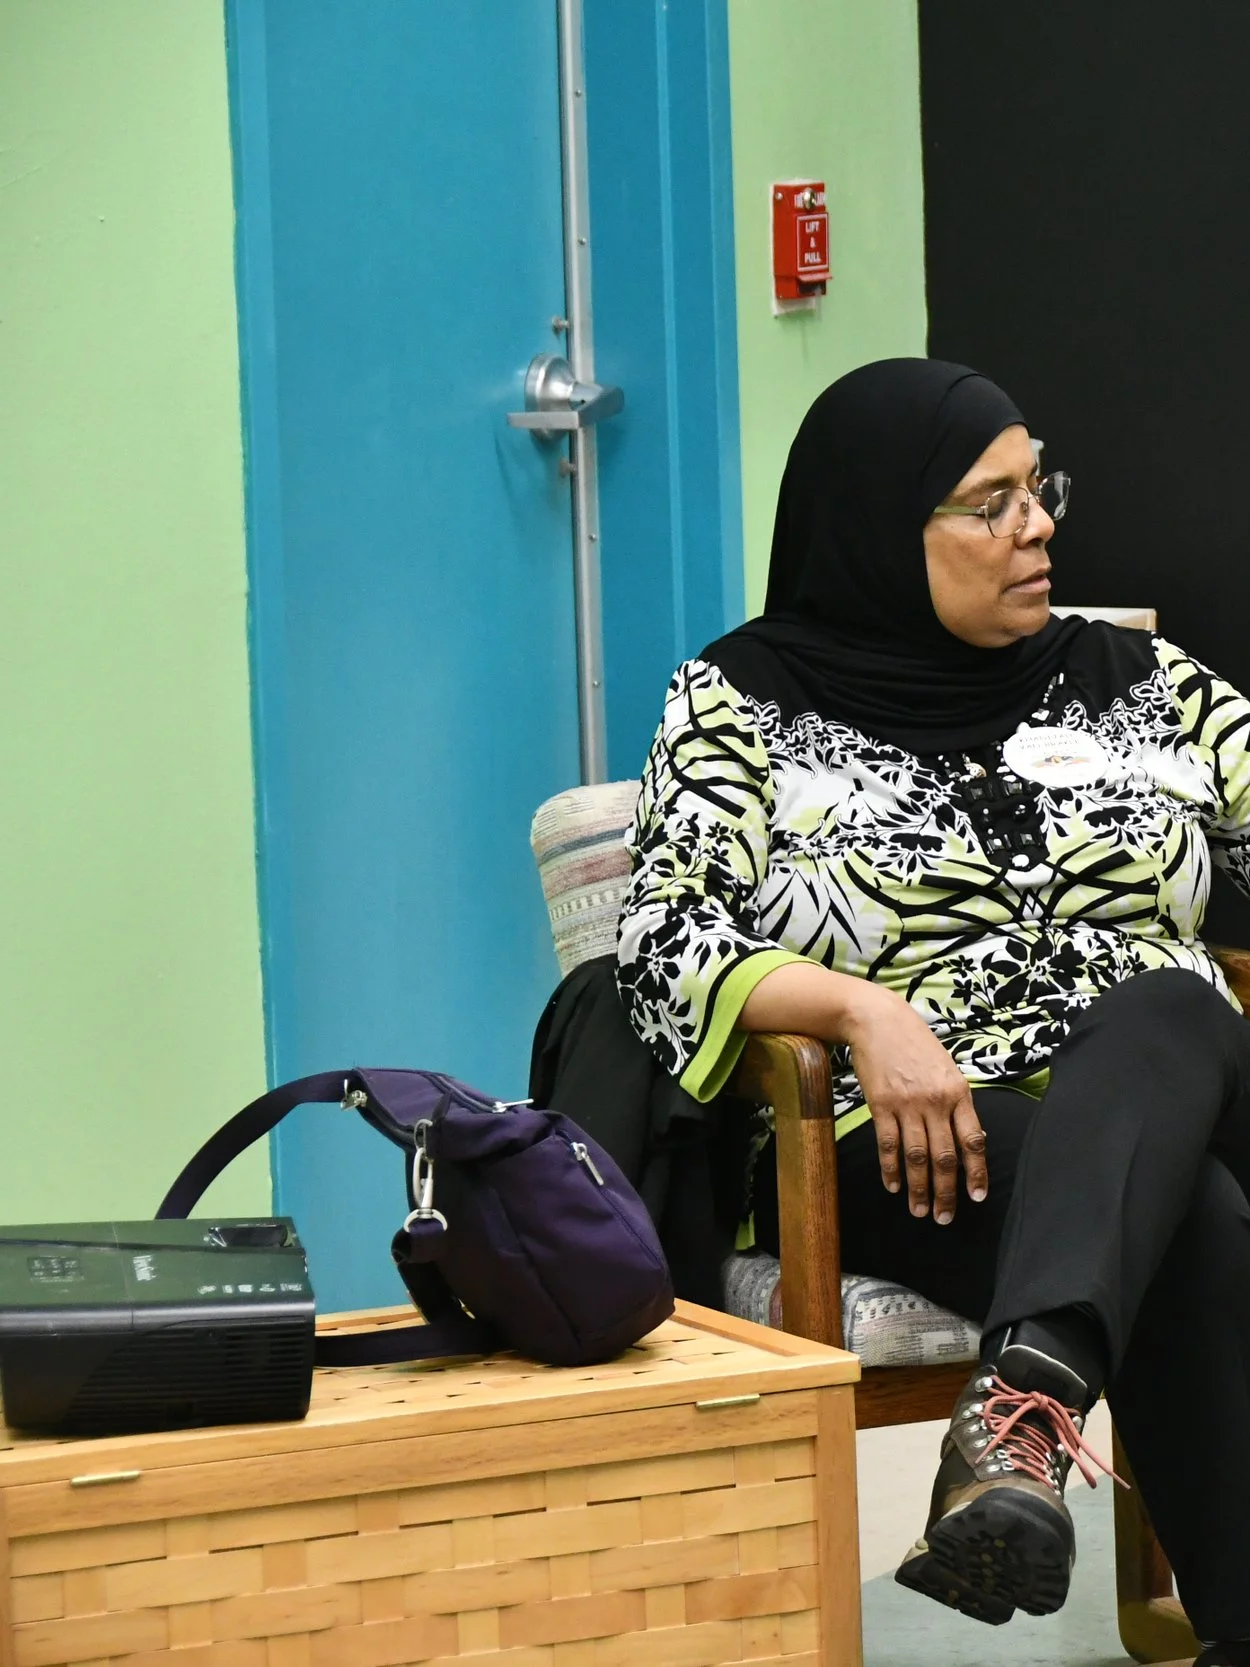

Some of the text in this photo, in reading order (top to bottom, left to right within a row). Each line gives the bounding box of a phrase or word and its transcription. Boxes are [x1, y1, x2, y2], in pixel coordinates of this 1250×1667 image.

[805, 221, 820, 233] LIFT
[810, 236, 817, 248] &
[804, 252, 821, 264] PULL
